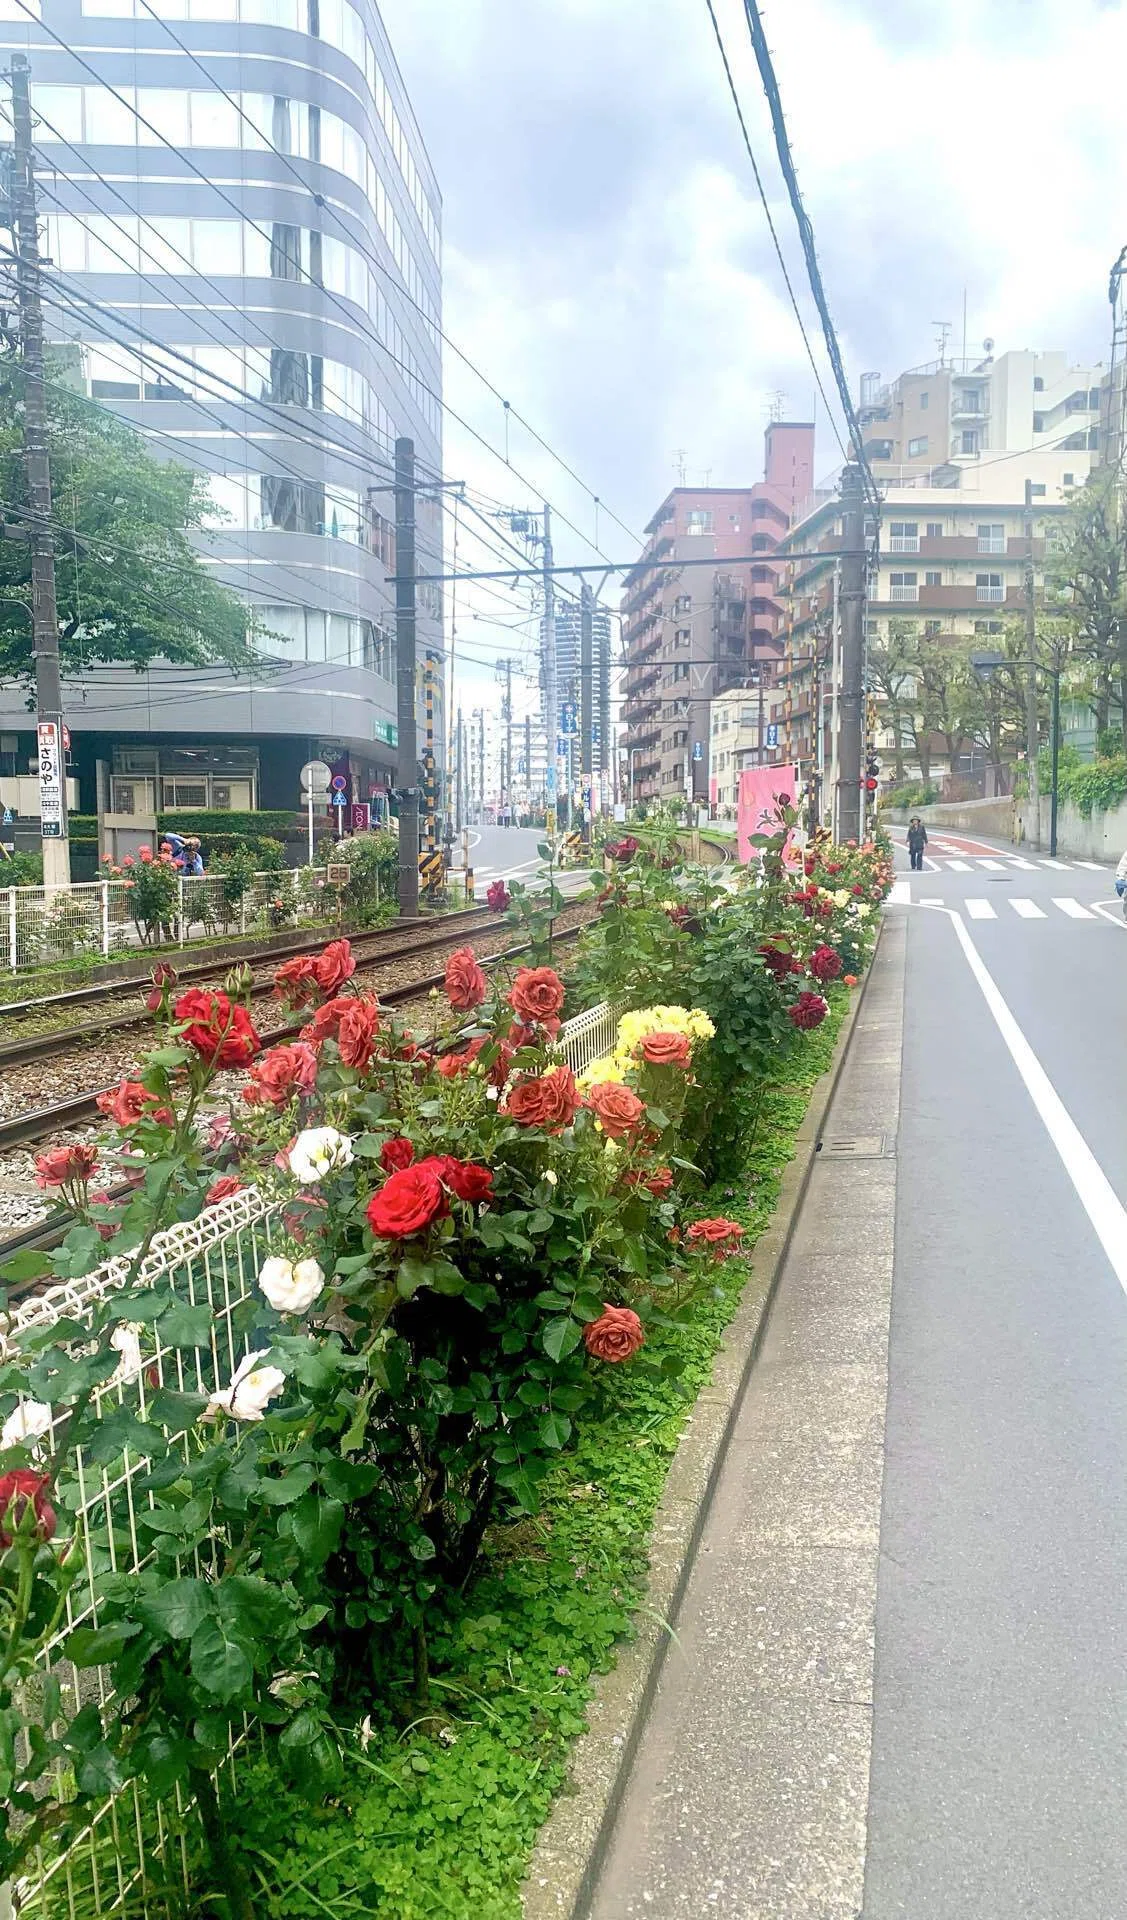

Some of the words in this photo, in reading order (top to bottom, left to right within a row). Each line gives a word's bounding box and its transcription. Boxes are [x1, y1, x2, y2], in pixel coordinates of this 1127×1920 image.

[41, 747, 53, 785] さのや
[330, 867, 348, 879] 25
